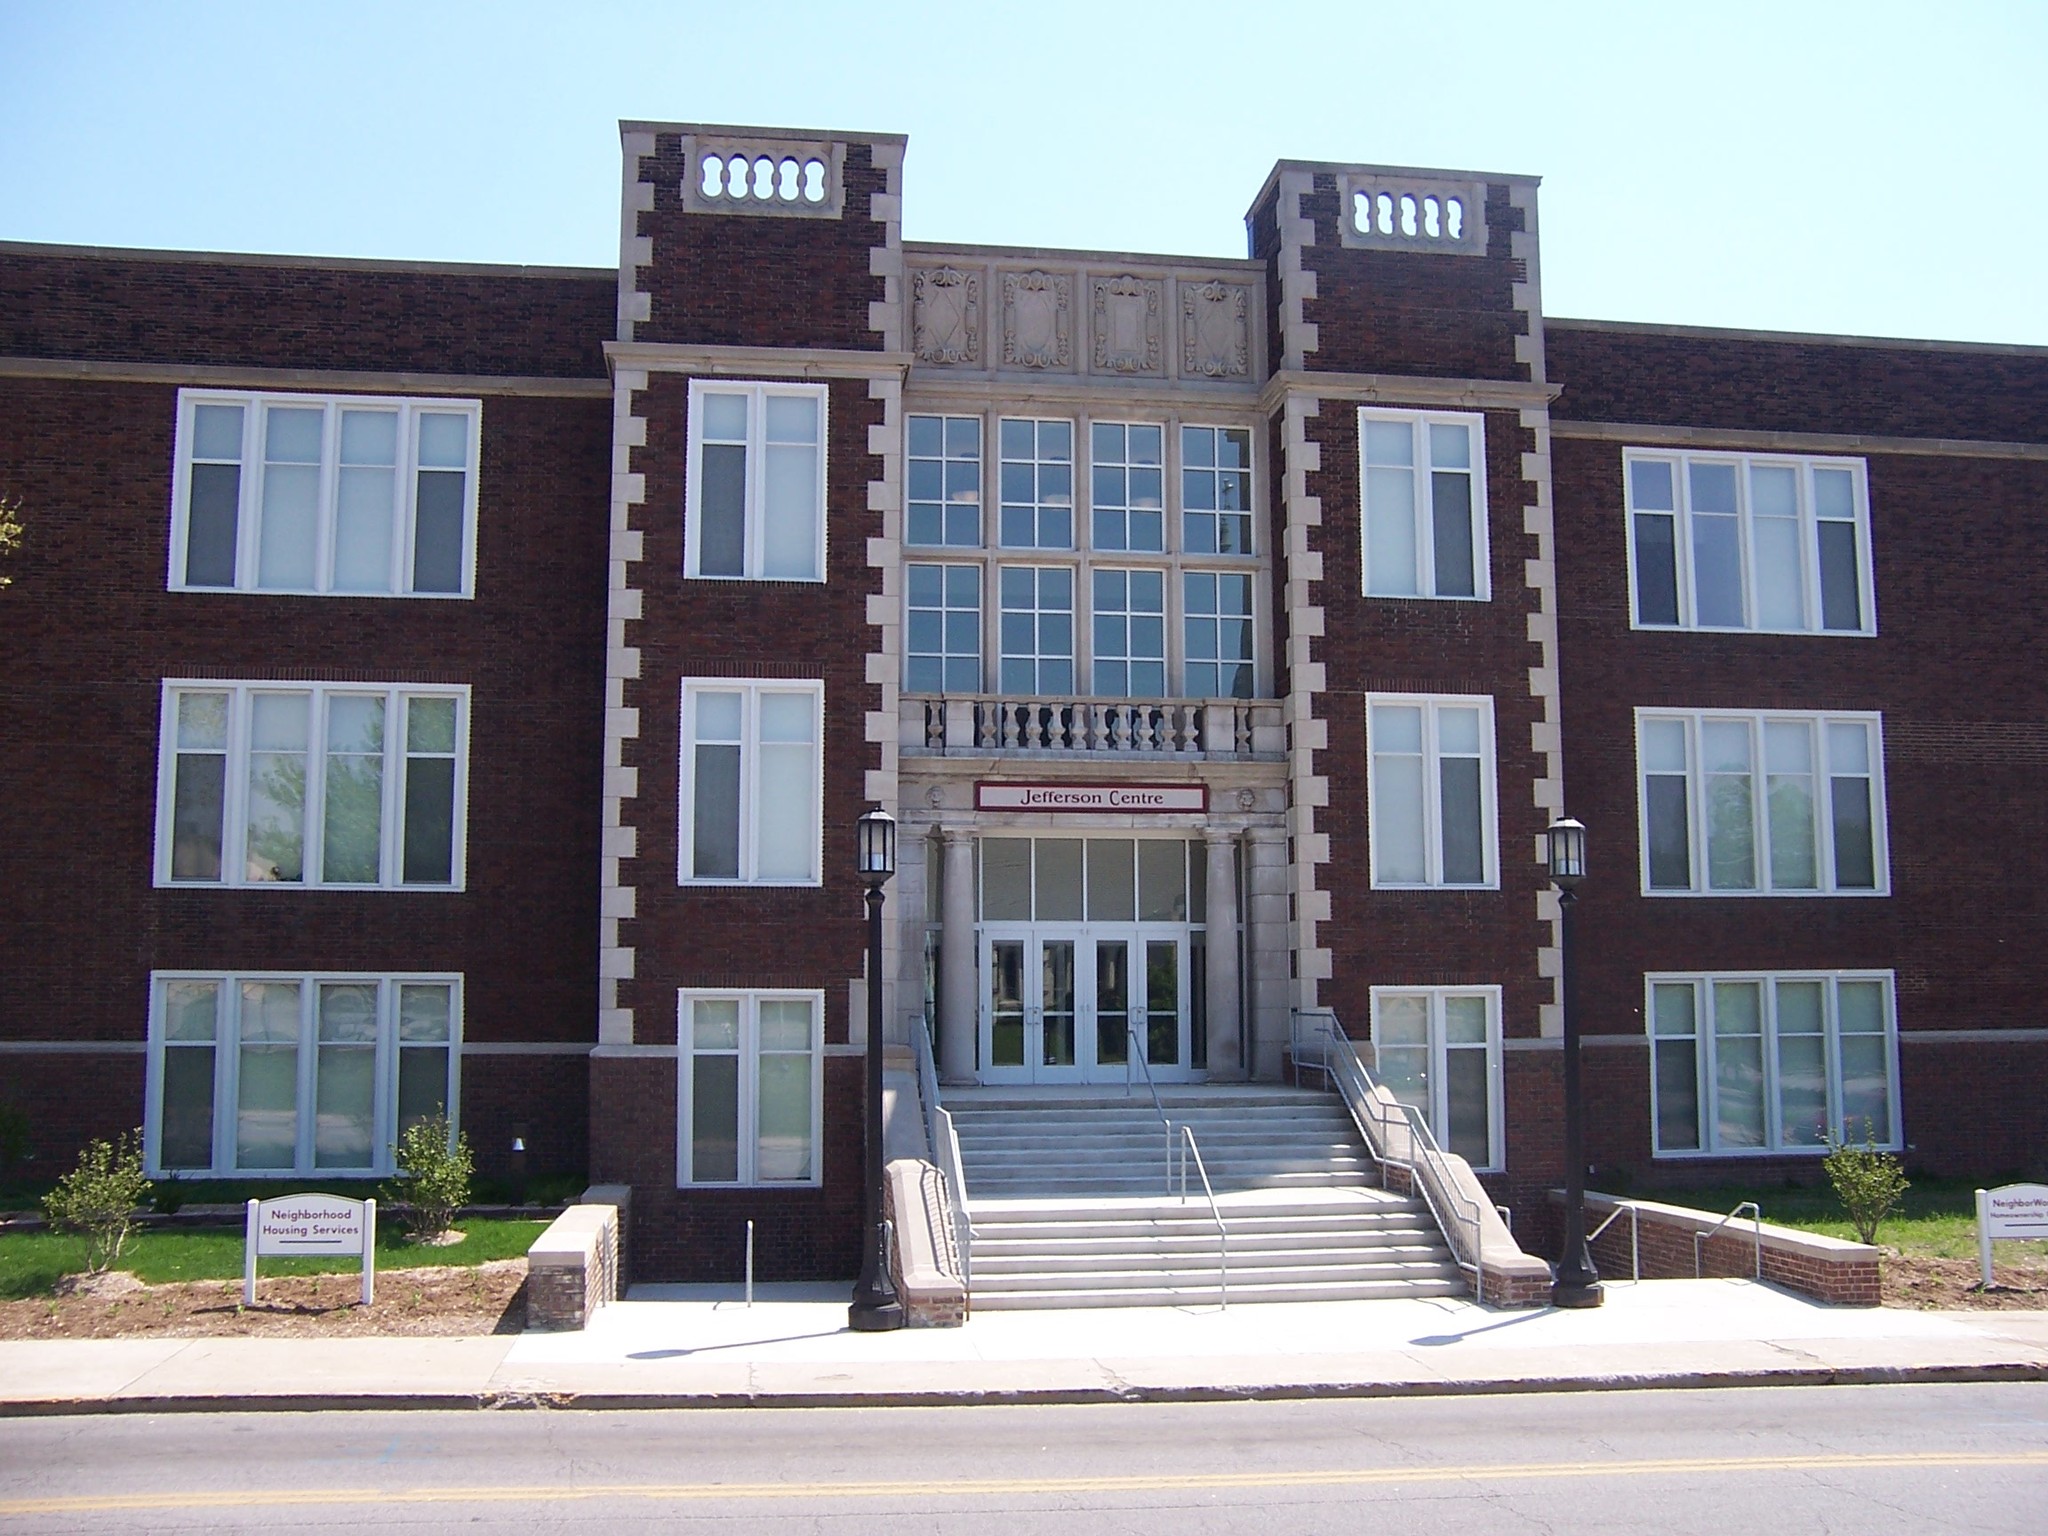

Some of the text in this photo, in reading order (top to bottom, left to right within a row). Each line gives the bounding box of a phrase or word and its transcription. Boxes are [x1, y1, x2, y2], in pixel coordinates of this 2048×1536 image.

[1020, 789, 1164, 806] Jefferson Centre
[1992, 1198, 2048, 1210] NeighborWo
[271, 1209, 352, 1222] Neighborhood
[262, 1225, 359, 1237] Housing Services
